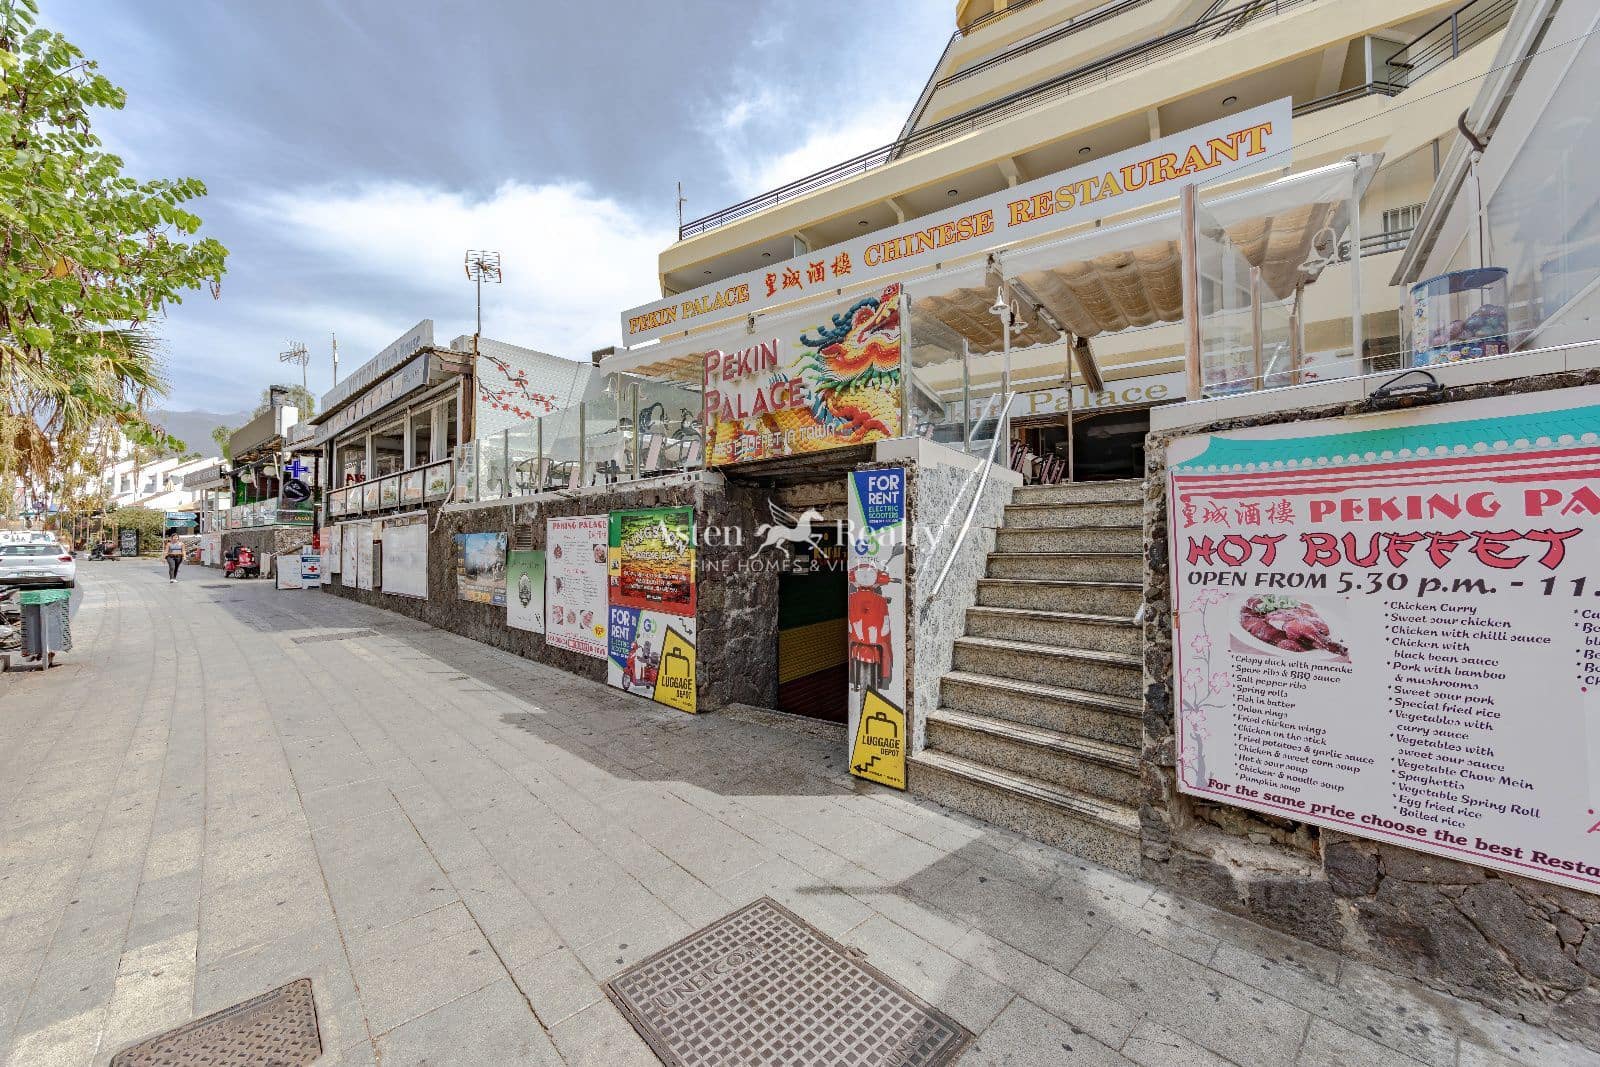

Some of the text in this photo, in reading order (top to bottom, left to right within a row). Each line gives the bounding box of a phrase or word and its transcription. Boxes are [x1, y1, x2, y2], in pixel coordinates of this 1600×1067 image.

[863, 122, 1272, 267] CHINESE RESTAURANT
[628, 284, 750, 334] PEKIN PALACE
[704, 338, 778, 386] PEKIN
[704, 378, 805, 426] PALACE
[1027, 384, 1168, 414] Palace
[868, 474, 899, 491] FOR
[868, 491, 899, 505] RENT
[1310, 492, 1502, 523] PEKING
[1186, 528, 1583, 570] HOT BUFFET
[1187, 572, 1247, 588] OPEN
[1254, 572, 1327, 589] FROM
[1337, 572, 1408, 595] 5.30
[1418, 578, 1497, 597] p.m.
[612, 608, 630, 626] FOR
[1390, 601, 1477, 615] Chicken Curry
[1391, 613, 1426, 623] Sweet
[1460, 618, 1512, 628] chicken
[612, 625, 630, 640] RENT
[1392, 626, 1551, 644] Chicken with chilli sauce
[1392, 638, 1470, 651] Chicken with
[1288, 660, 1309, 670] with
[1311, 663, 1352, 674] pancake
[1394, 650, 1499, 666] black bean sauce
[1236, 674, 1254, 684] Salt
[1290, 670, 1310, 681] BBQ
[1393, 662, 1506, 680] Pork with bamboo
[1395, 674, 1402, 682] &
[662, 676, 692, 690] LUGGAGE
[1237, 684, 1266, 696] Spring
[1394, 686, 1494, 705] Sweet sour pork
[1395, 698, 1500, 719] Special fried rice
[1396, 710, 1494, 731] Vegetables with
[1397, 724, 1469, 740] curry sauce
[862, 735, 900, 750] LUGGAGE
[1397, 734, 1494, 757] Vegetables with
[880, 748, 900, 758] DEPOT
[1274, 750, 1281, 758] &
[1336, 763, 1360, 774] soup
[1304, 746, 1311, 754] &
[1312, 747, 1343, 760] garlic
[1345, 755, 1375, 764] sauce
[1398, 748, 1504, 771] sweet sour sauce
[1286, 764, 1308, 774] soup
[1398, 758, 1534, 790] Vegetable Chow Mein
[1278, 770, 1284, 779] &
[1320, 781, 1344, 792] soup
[1280, 782, 1301, 794] soup
[1399, 782, 1541, 818] Vegetable Spring Roll
[1399, 795, 1482, 819] Egg fried rice
[1208, 778, 1232, 791] For
[1235, 783, 1259, 798] the
[1263, 791, 1306, 809] same
[1310, 800, 1356, 820] price
[1360, 810, 1427, 838] choose
[1433, 827, 1468, 848] the
[1474, 836, 1524, 860] best
[1442, 818, 1466, 828] rice
[655, 952, 746, 1009] UNELCO
